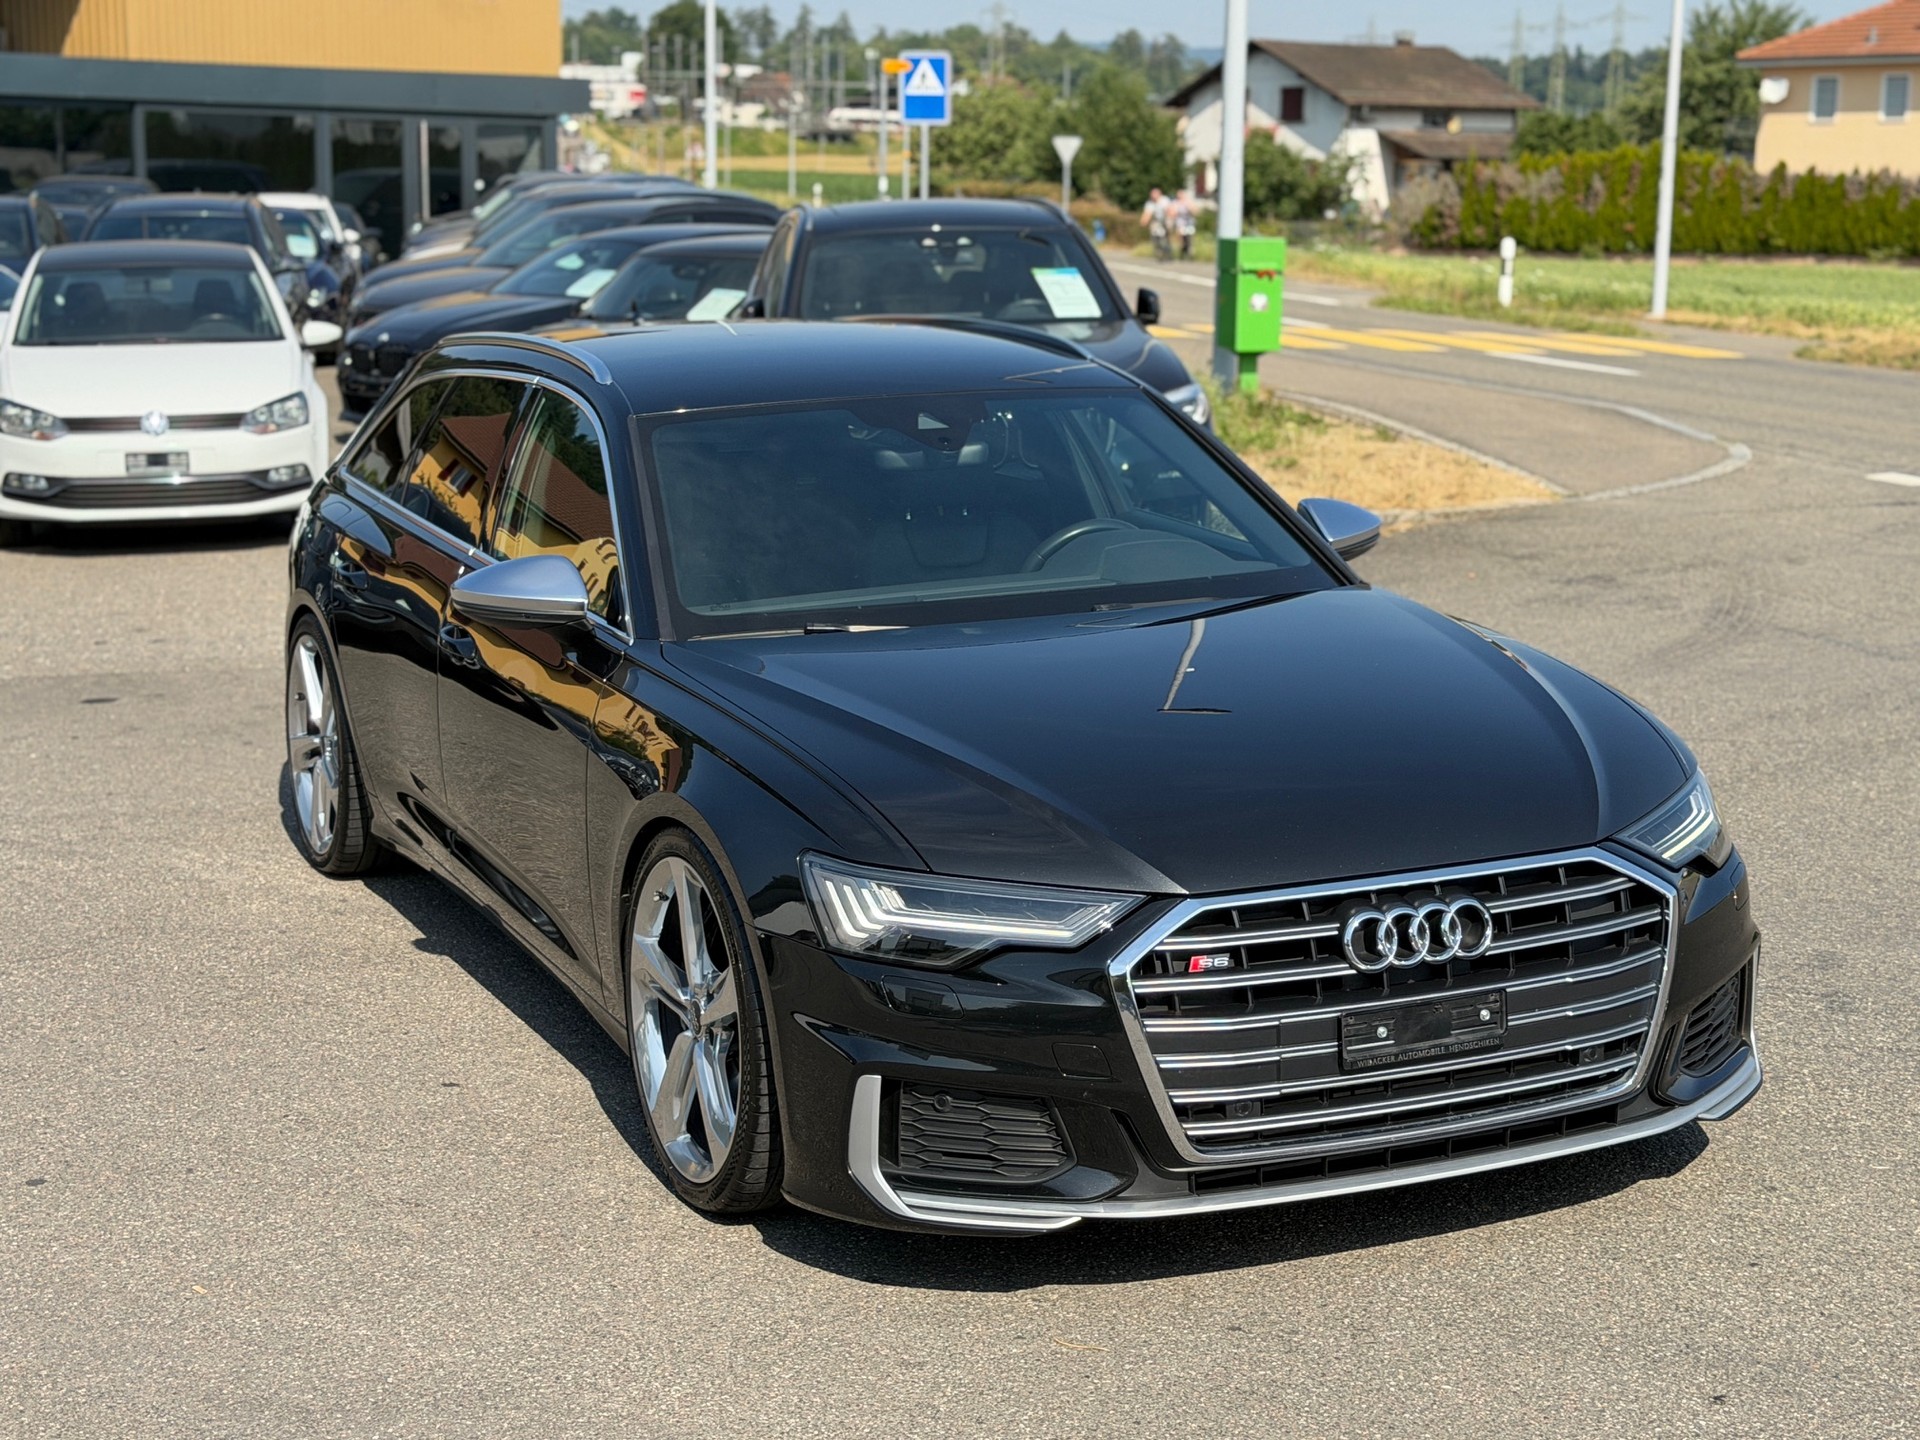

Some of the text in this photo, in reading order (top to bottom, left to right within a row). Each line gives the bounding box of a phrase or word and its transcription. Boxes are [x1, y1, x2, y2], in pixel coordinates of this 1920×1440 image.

[1198, 957, 1230, 968] S6
[1397, 1046, 1446, 1061] AUTOMOBILE
[1448, 1037, 1501, 1053] HENDSCHIKEN
